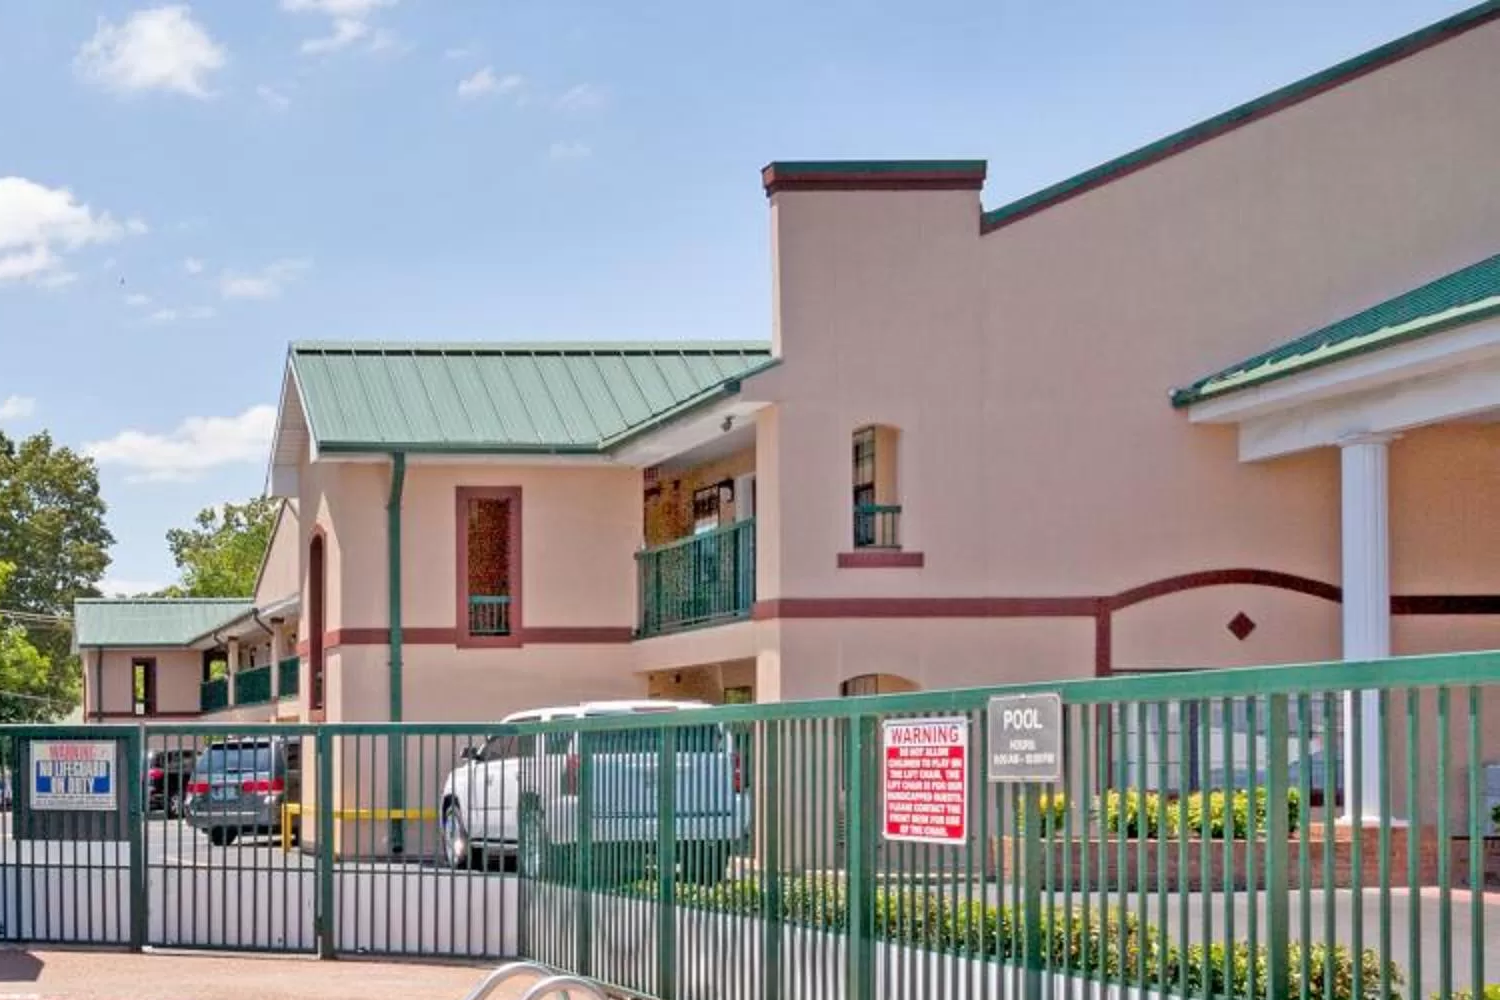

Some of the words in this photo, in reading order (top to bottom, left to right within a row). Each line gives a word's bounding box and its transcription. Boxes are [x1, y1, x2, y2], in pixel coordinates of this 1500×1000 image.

[1003, 708, 1043, 731] POOL
[891, 725, 959, 744] WARNING
[68, 777, 94, 794] DUTY
